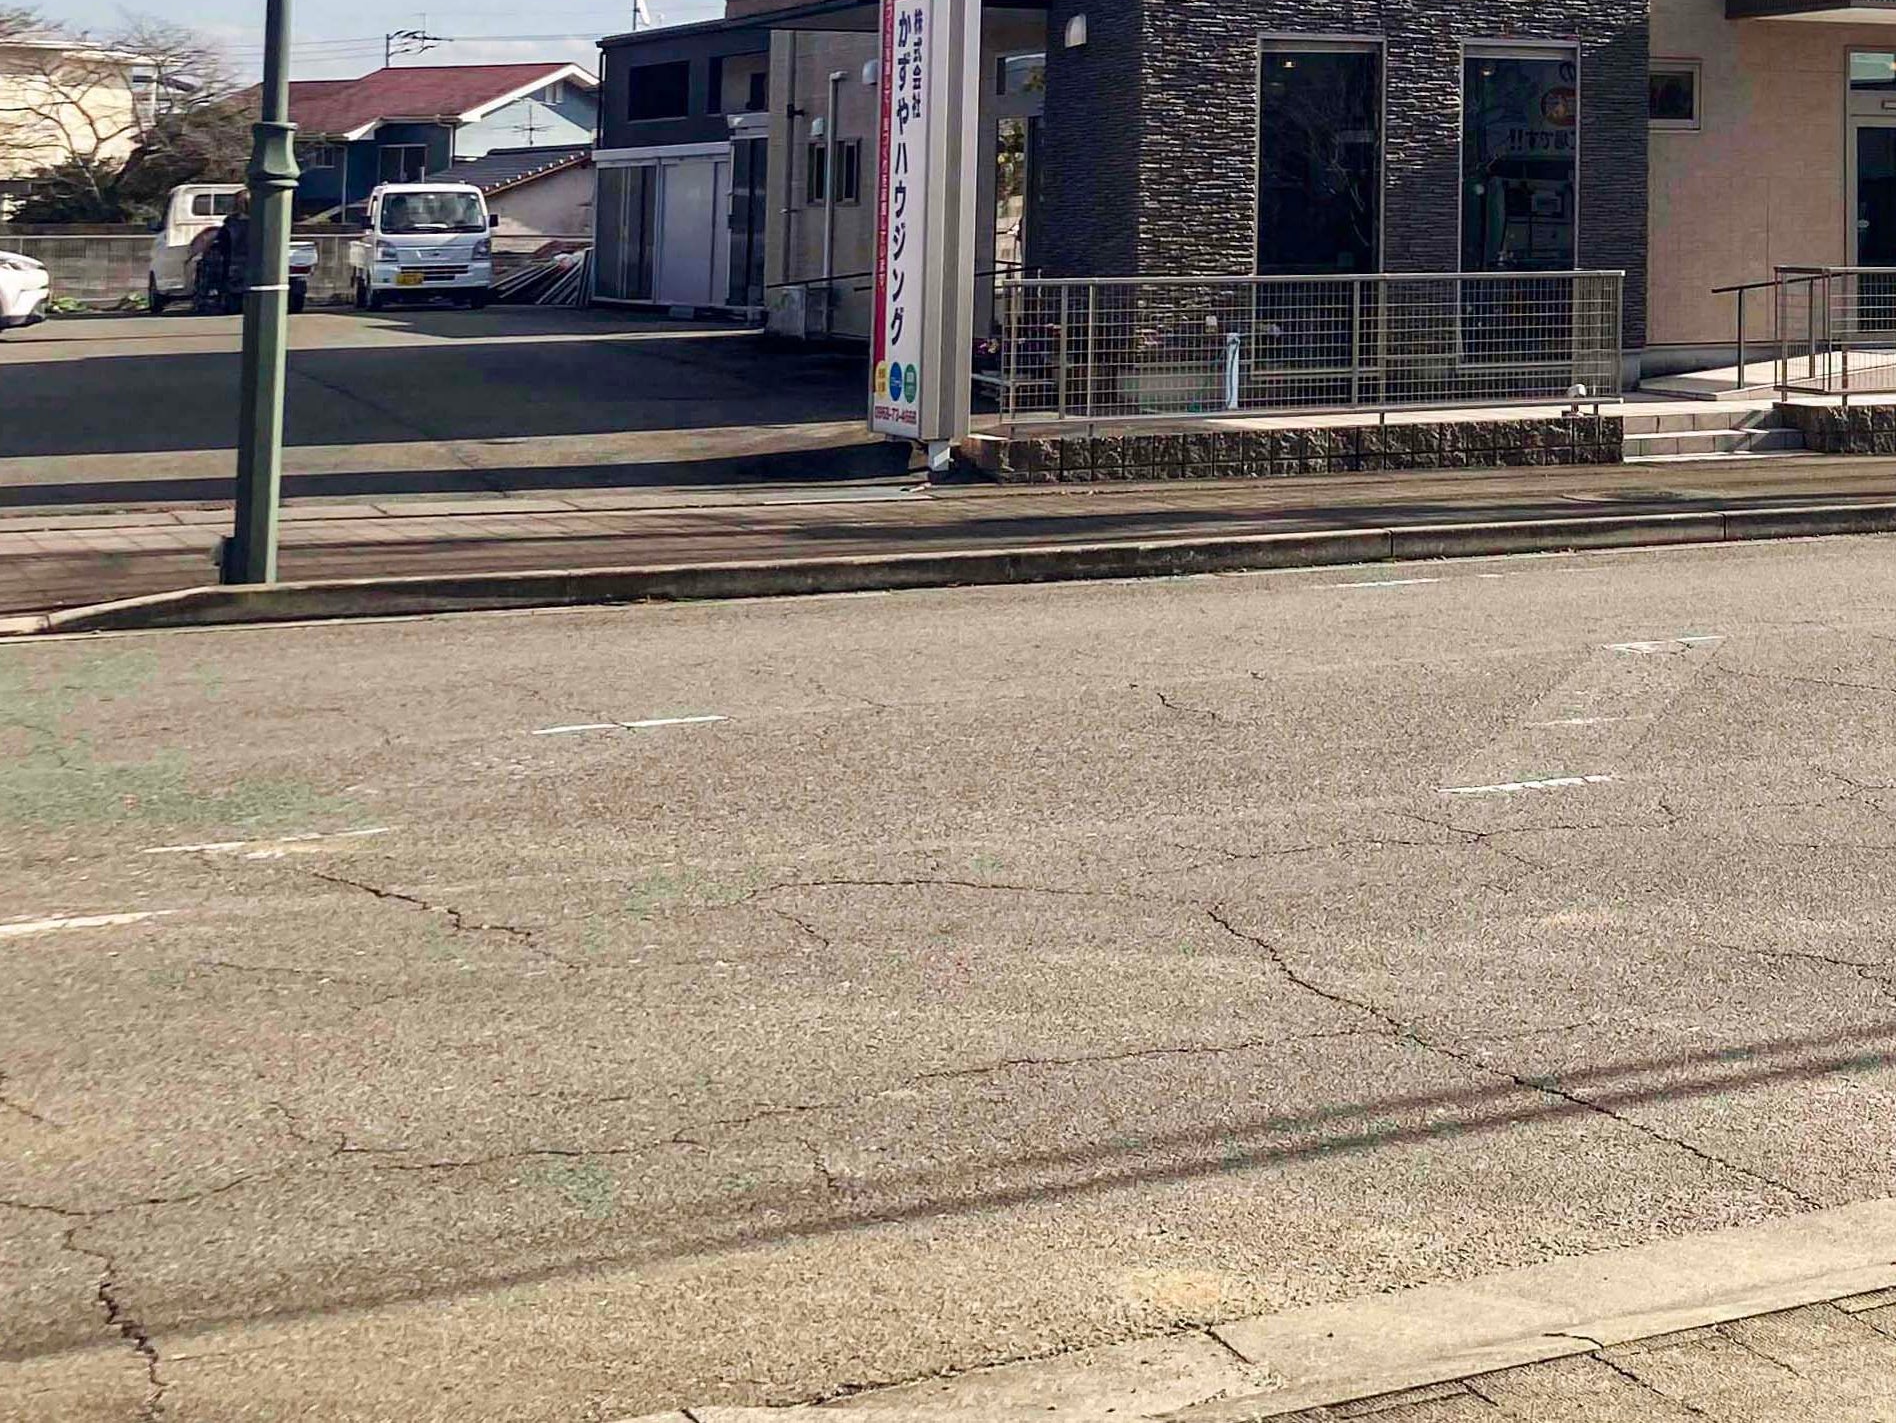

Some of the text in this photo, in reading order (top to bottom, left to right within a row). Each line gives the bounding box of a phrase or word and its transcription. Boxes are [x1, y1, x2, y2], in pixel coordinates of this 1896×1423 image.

[912, 8, 923, 118] 株式会社
[890, 11, 911, 346] かずやハウジング
